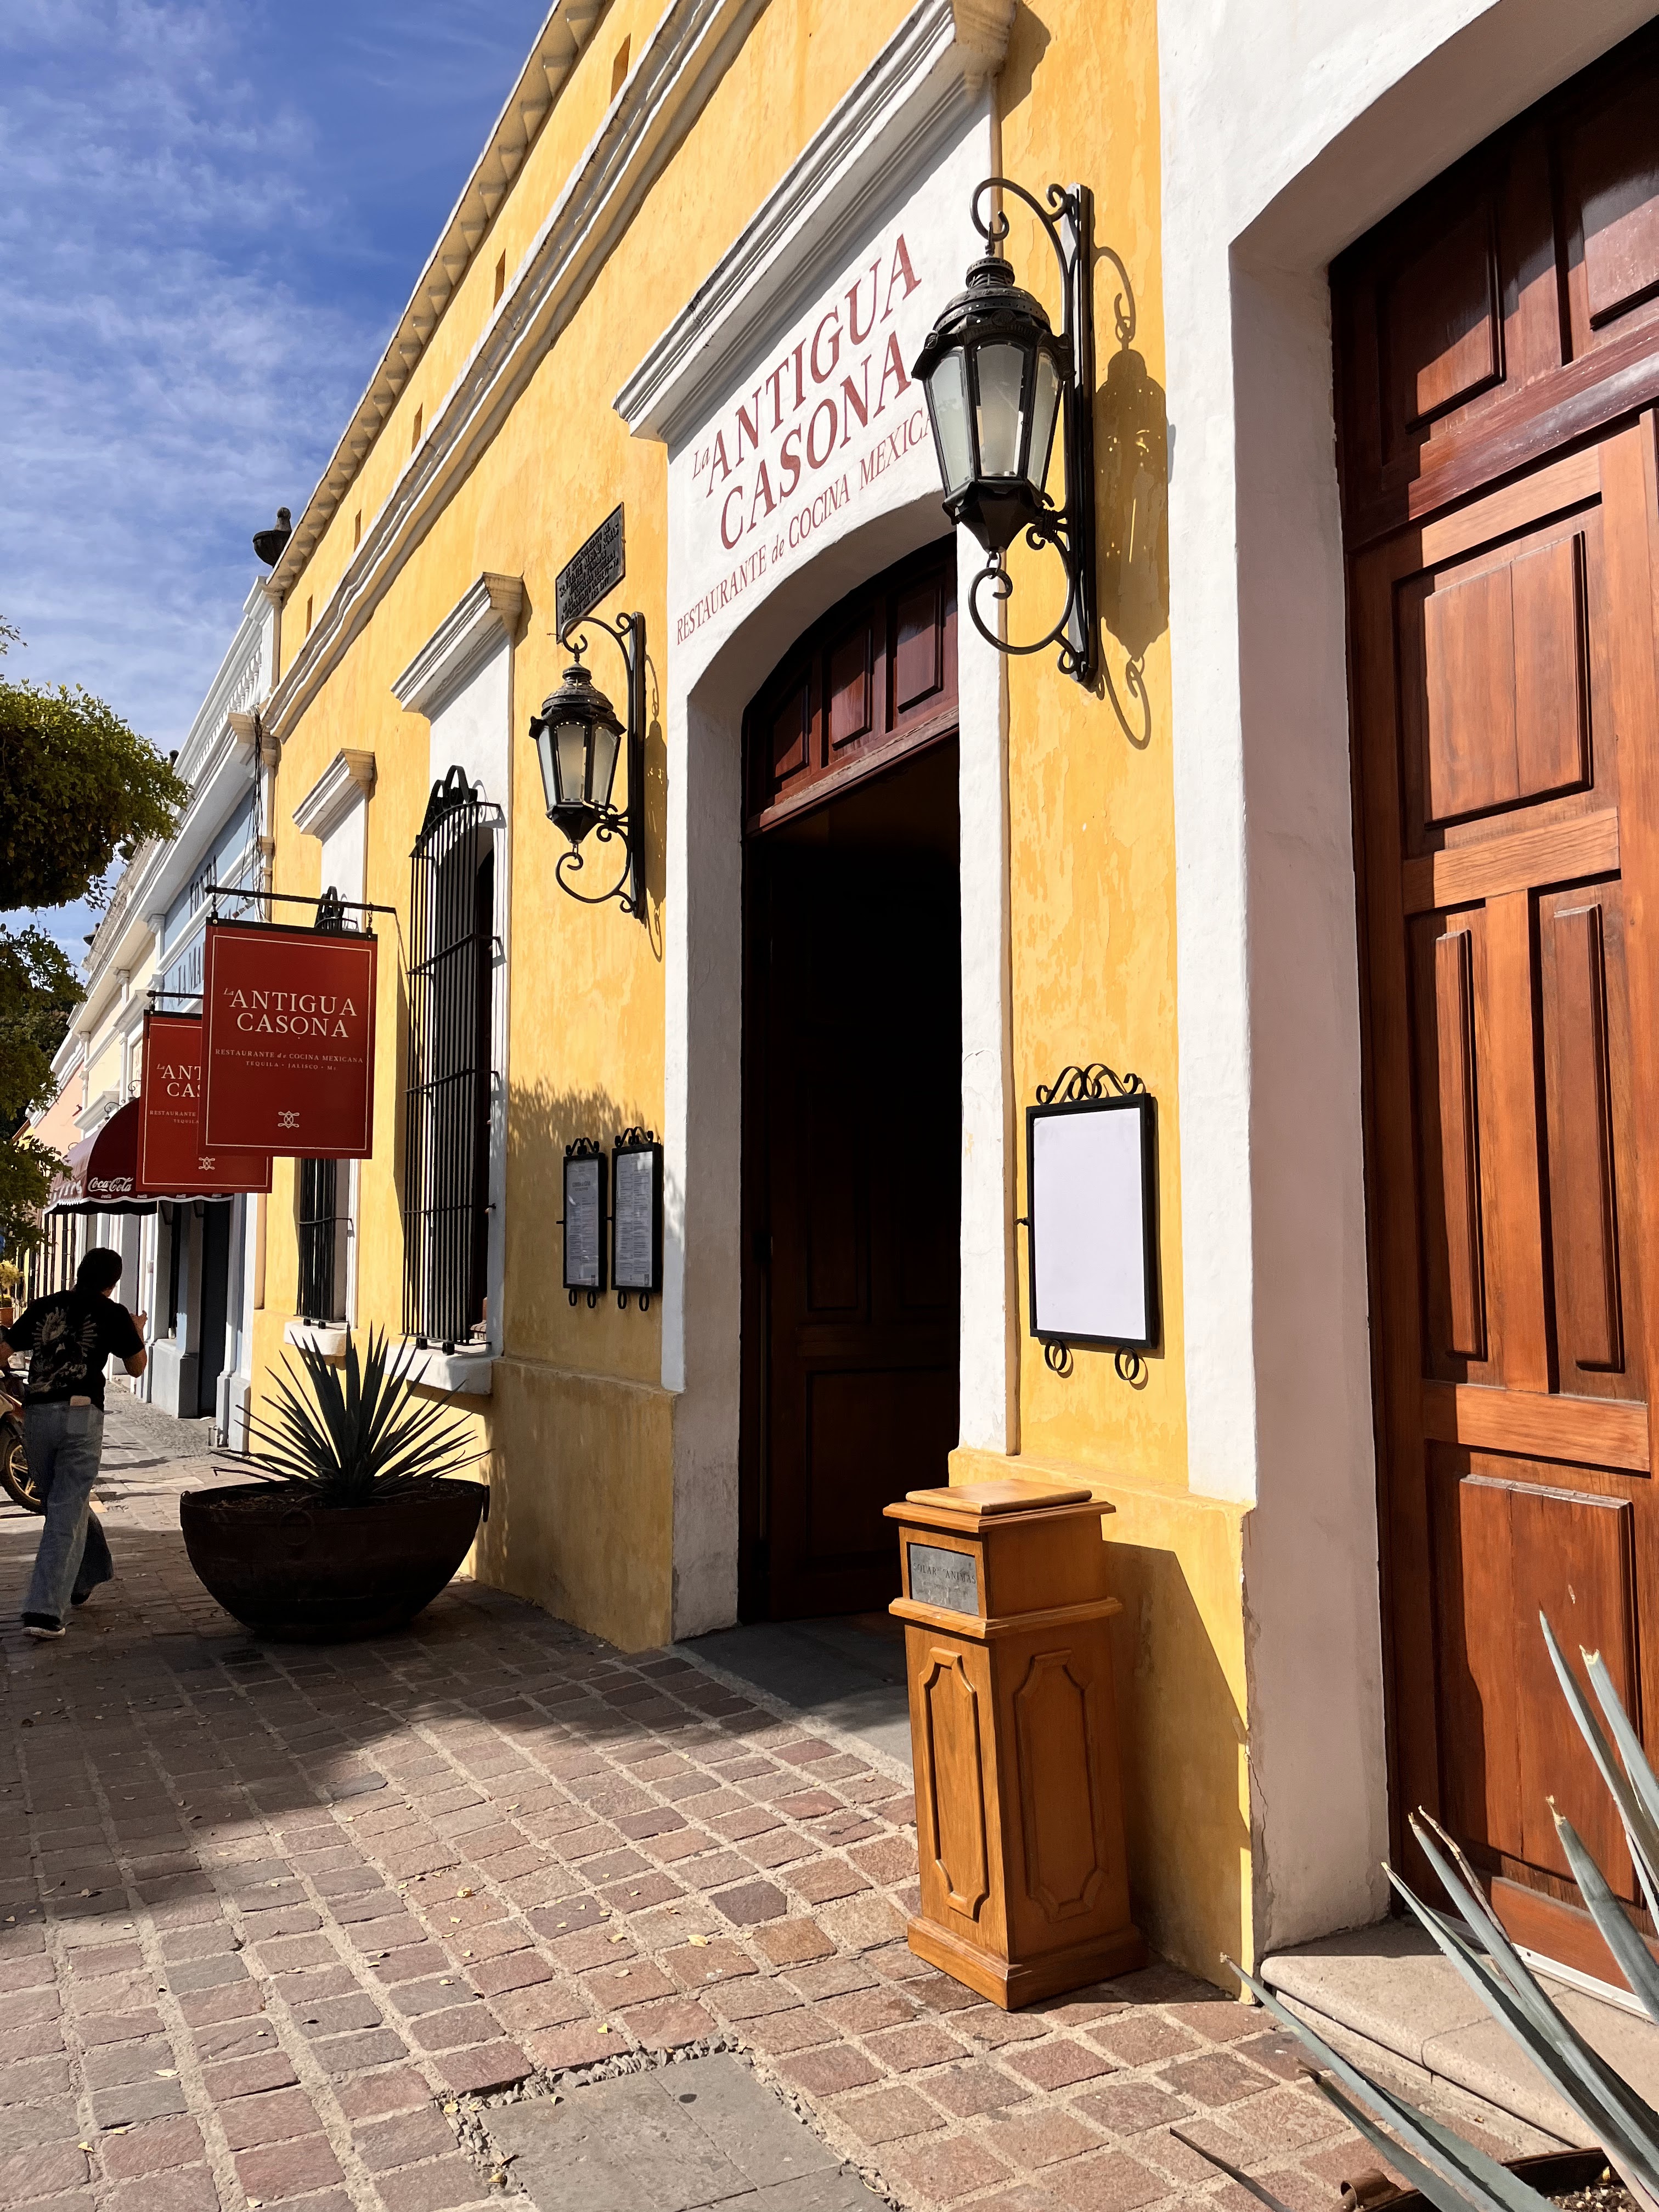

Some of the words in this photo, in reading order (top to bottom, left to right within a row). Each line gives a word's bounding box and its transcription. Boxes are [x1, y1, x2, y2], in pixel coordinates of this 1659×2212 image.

[692, 447, 710, 480] La
[706, 233, 922, 498] ANTIGUA
[720, 329, 912, 550] CASONA
[676, 544, 767, 646] RESTAURANTE
[771, 534, 785, 564] de
[788, 473, 851, 549] COCINA
[223, 988, 234, 996] La
[229, 989, 358, 1017] ANTIGUA
[237, 1012, 349, 1038] CASONA
[215, 1048, 275, 1058] RESTAURANTE
[322, 1055, 363, 1064] MEXICANA
[913, 1562, 937, 1576] SOLAR
